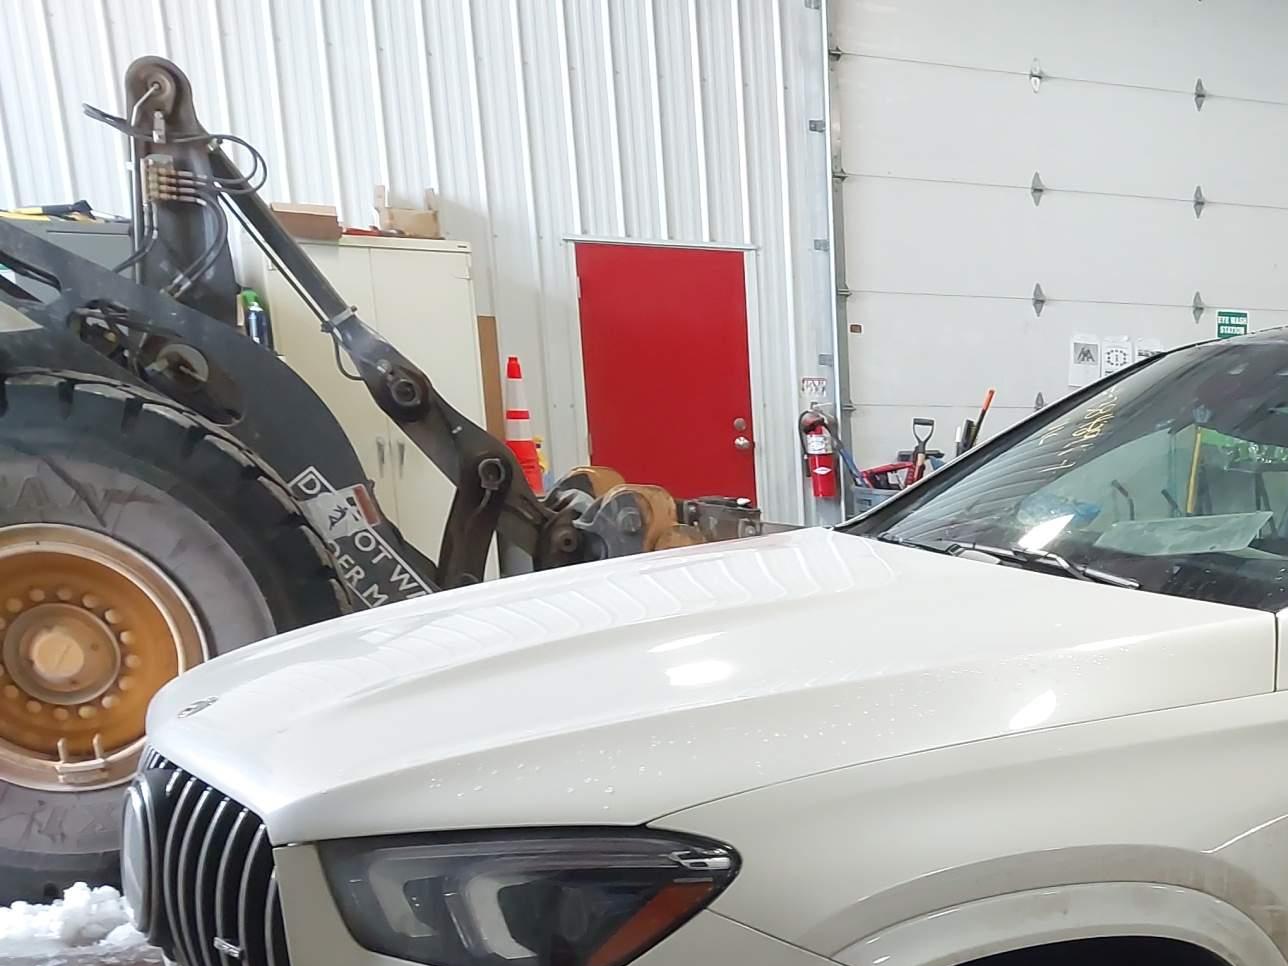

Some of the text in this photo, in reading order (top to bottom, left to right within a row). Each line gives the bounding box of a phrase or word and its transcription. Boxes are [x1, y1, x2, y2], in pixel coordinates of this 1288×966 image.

[298, 473, 321, 495] D
[354, 530, 393, 564] OT
[362, 583, 389, 608] M
